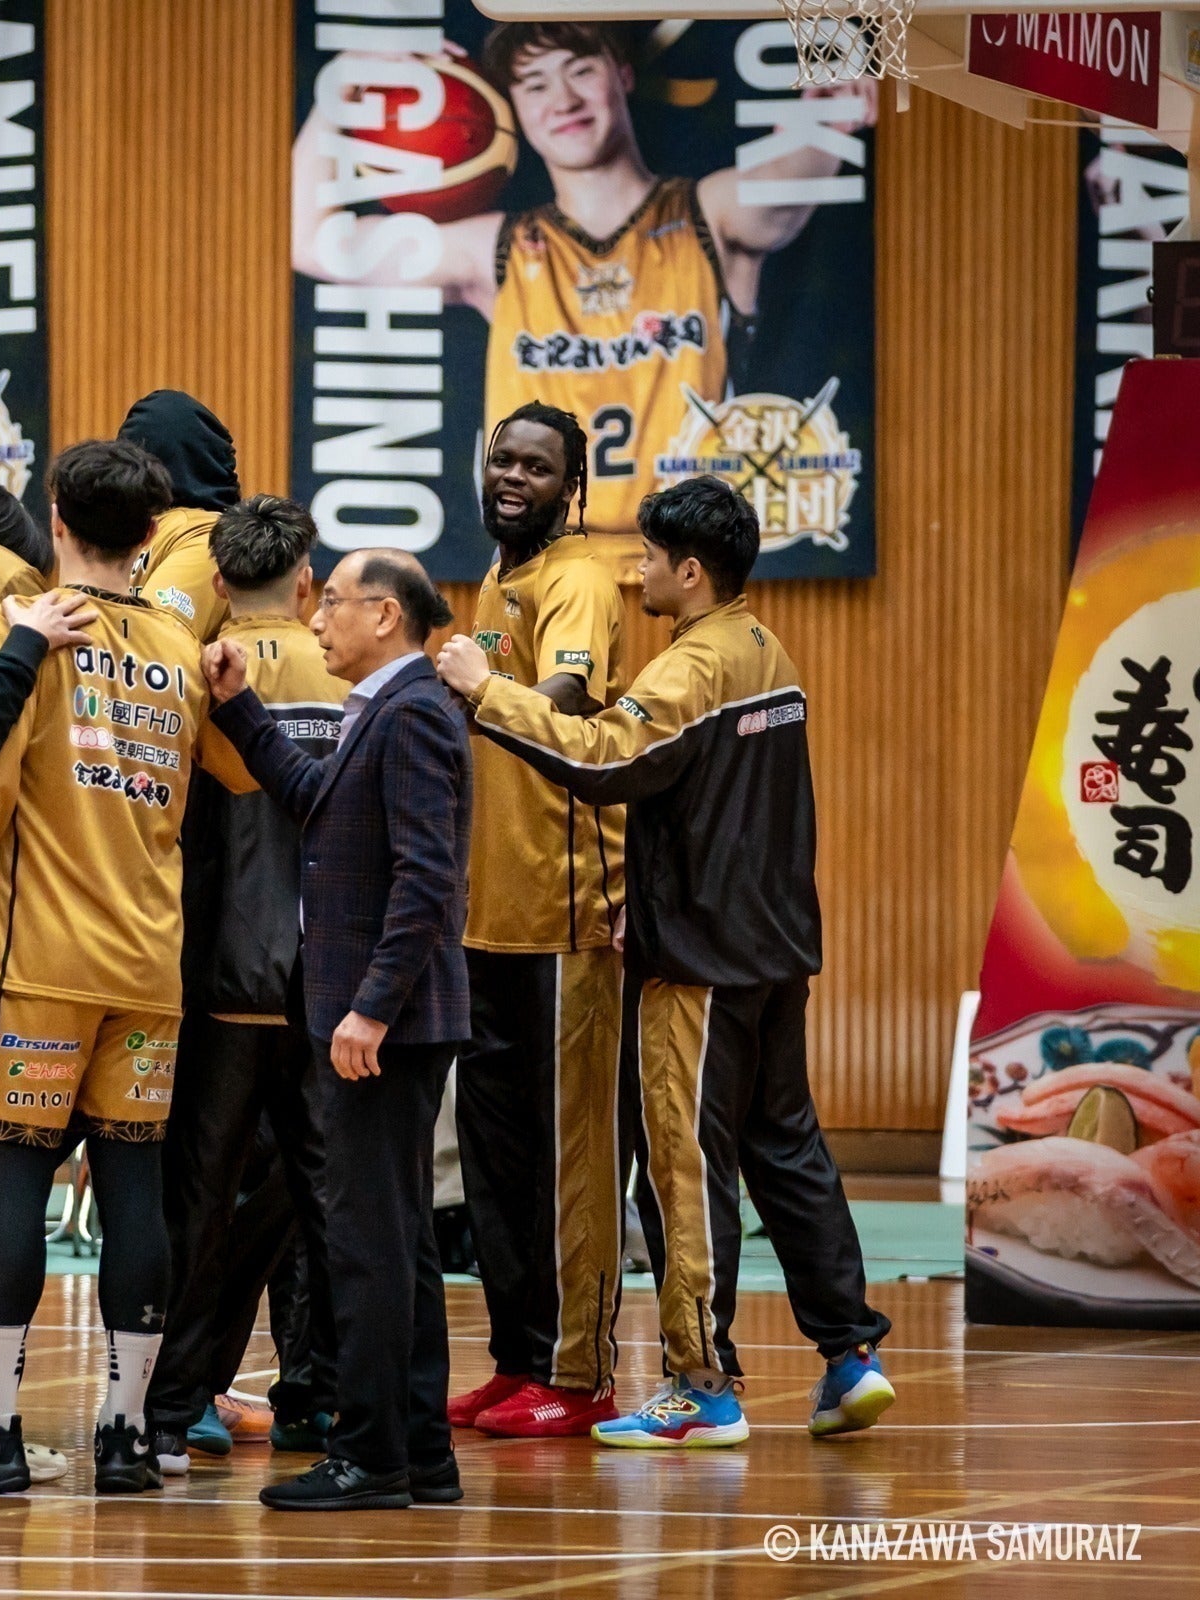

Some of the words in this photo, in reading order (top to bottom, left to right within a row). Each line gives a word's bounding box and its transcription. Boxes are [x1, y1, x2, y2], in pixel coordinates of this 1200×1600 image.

[1016, 13, 1149, 86] MAIMON
[723, 407, 800, 451] 金沢
[593, 403, 636, 481] 2
[121, 618, 129, 639] 1
[751, 626, 766, 648] 18
[256, 639, 278, 660] 11
[75, 646, 185, 701] antol
[619, 697, 646, 720] PURT
[7, 1091, 71, 1108] antol
